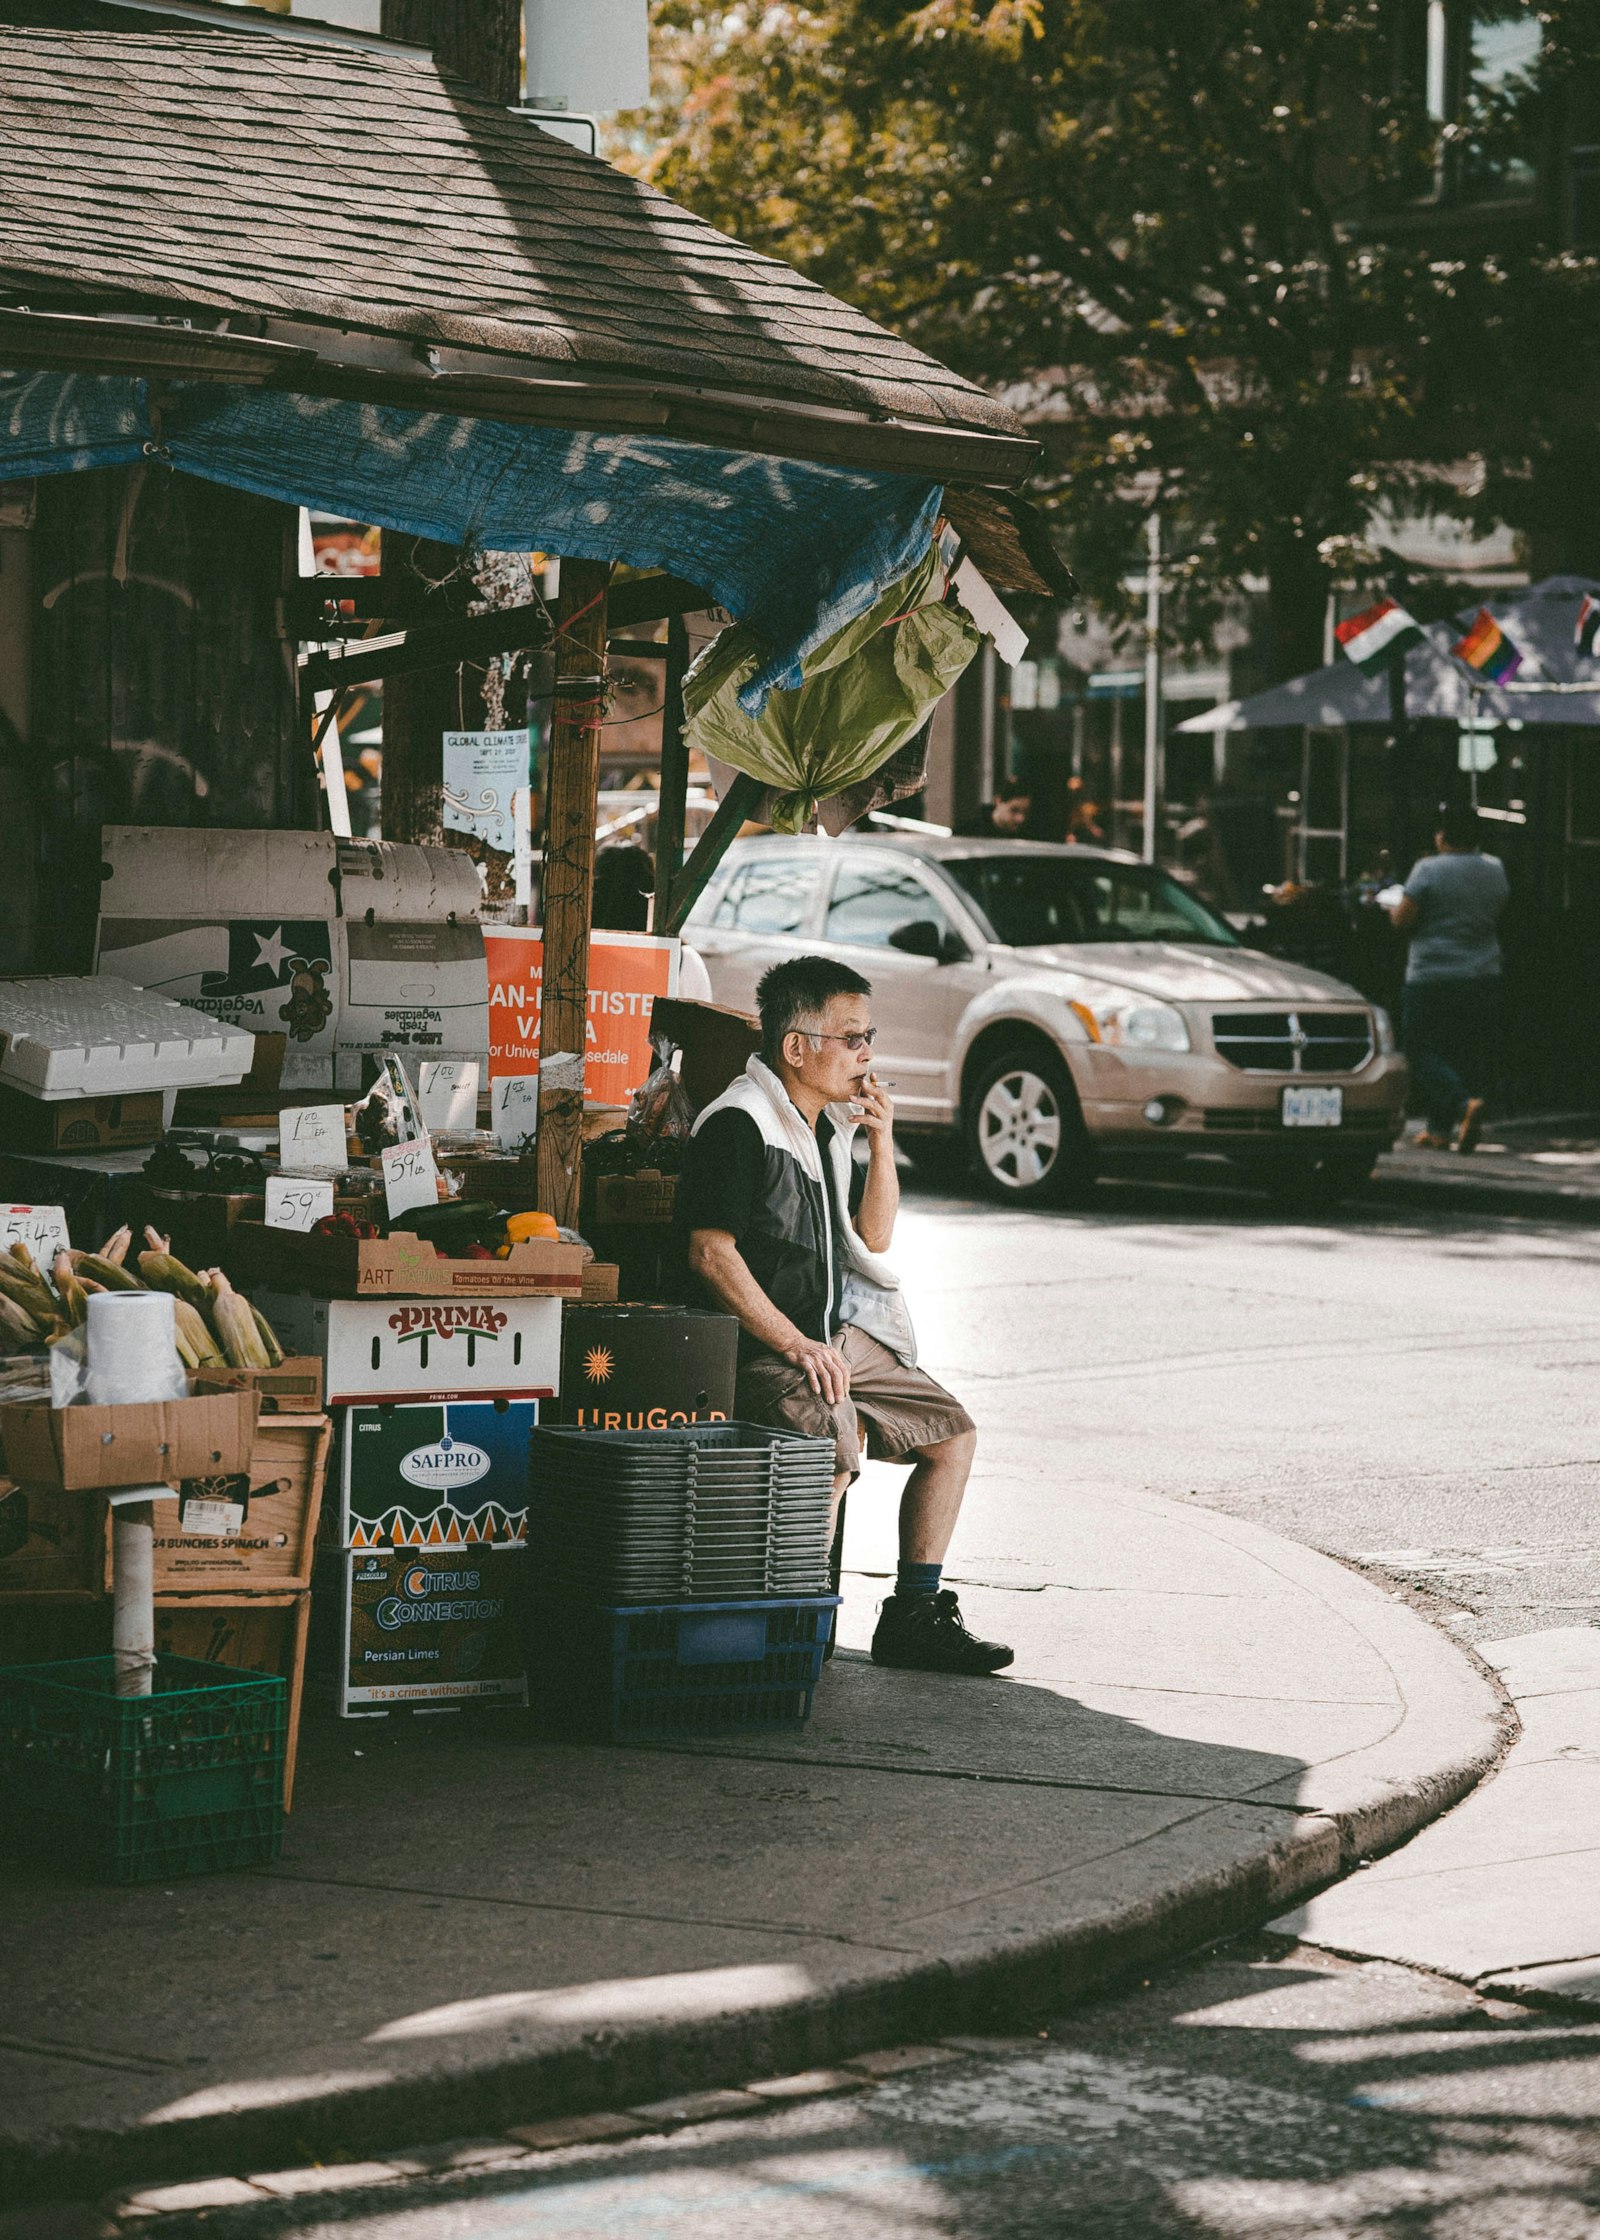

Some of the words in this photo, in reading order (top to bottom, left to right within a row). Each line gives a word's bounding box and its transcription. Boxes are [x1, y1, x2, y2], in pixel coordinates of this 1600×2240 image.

[448, 736, 480, 747] GLOBAL
[483, 735, 514, 746] CLIMATE
[384, 1008, 442, 1021] Vegetables
[399, 1021, 428, 1031] Fresh
[488, 1045, 503, 1055] or
[397, 1267, 451, 1285] FARMS
[454, 1274, 490, 1284] Tomatoes
[518, 1276, 535, 1285] Vine
[388, 1306, 508, 1339] PRIMA
[359, 1423, 382, 1431] CITRUS
[411, 1453, 481, 1469] SAFPRO
[152, 1538, 165, 1548] 24
[167, 1538, 219, 1549] BUNCHES
[221, 1538, 270, 1549] SPINACH
[403, 1565, 481, 1600] CITRUS
[376, 1596, 505, 1631] CONNECTION
[364, 1650, 406, 1663] Persian
[408, 1649, 440, 1661] Limes
[389, 1689, 396, 1698] a
[397, 1687, 427, 1697] crime
[430, 1684, 470, 1696] without
